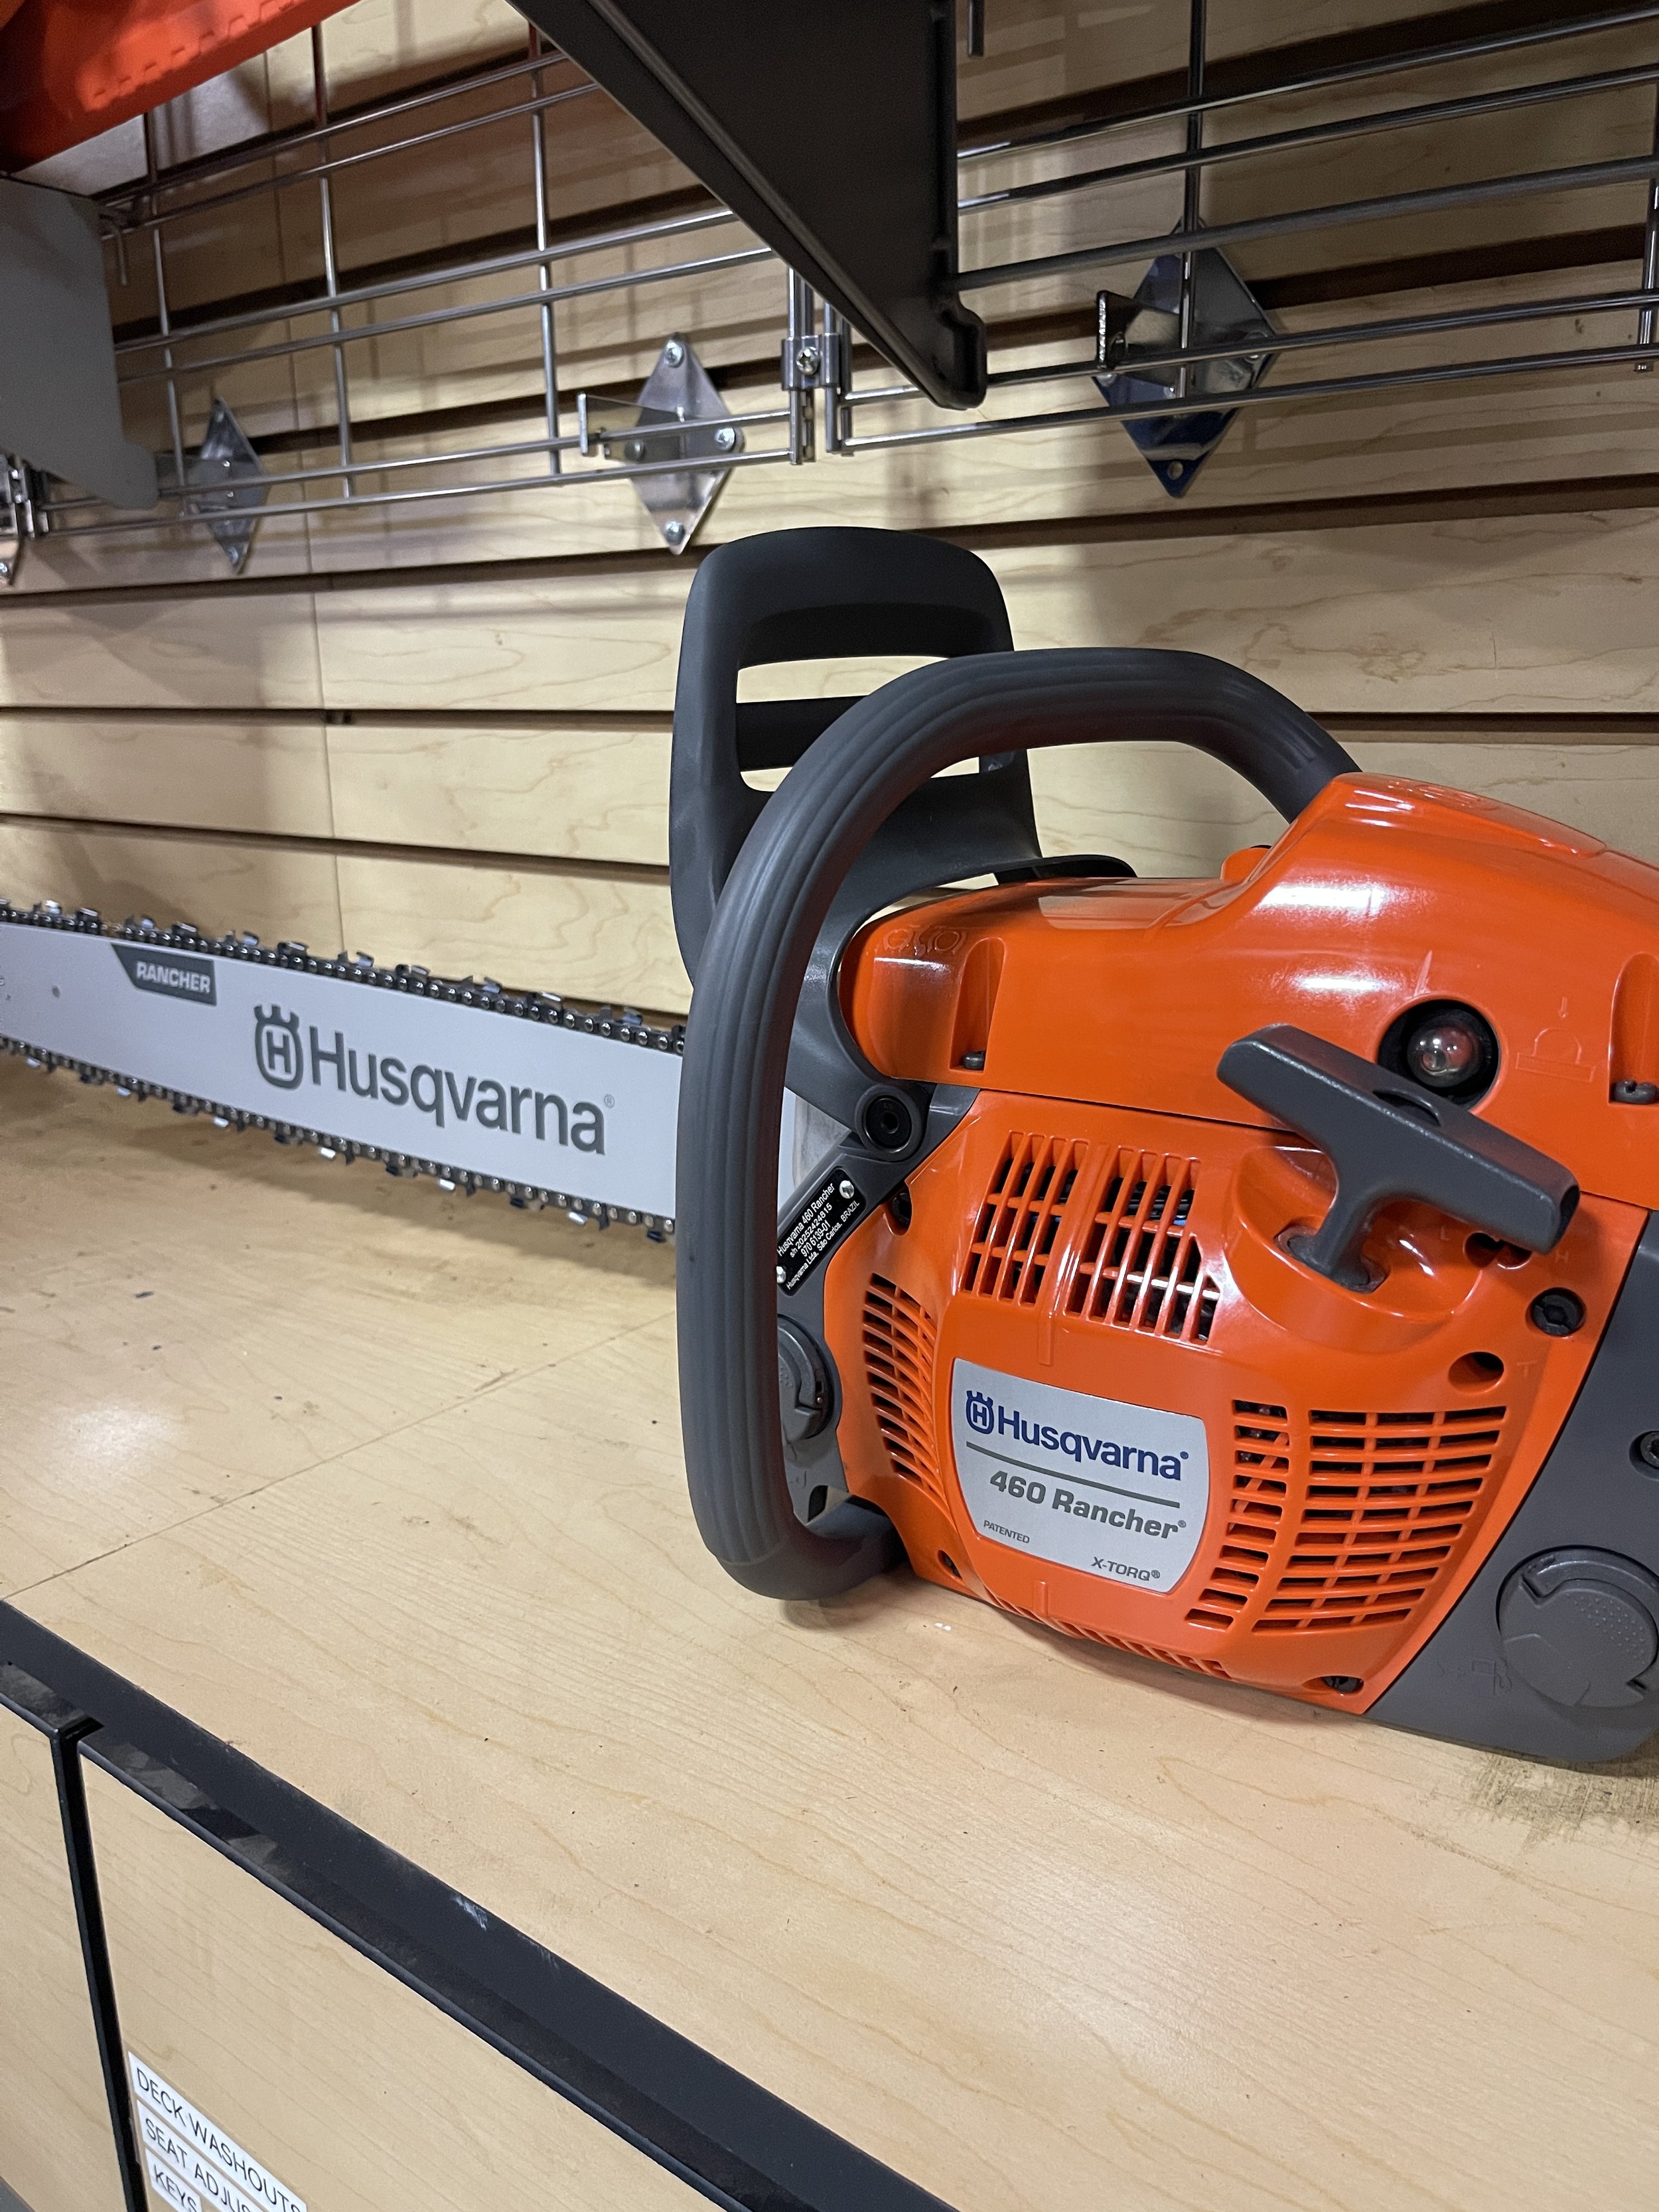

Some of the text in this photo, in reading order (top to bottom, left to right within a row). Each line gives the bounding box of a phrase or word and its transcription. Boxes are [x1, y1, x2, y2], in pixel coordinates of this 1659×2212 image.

[137, 961, 210, 994] RANCHER
[776, 1183, 835, 1256] Husqvarna 460 Rancher
[797, 1203, 832, 1251] 20252424815
[800, 1219, 831, 1257] 970 6139-01
[786, 1262, 808, 1290] Husqvarna
[840, 1201, 860, 1222] BRAZIL
[989, 1470, 1046, 1505] 460
[983, 1519, 1030, 1544] PATENTED
[137, 2067, 186, 2128] DECK
[145, 2118, 188, 2169] SEAT
[154, 2164, 197, 2212] KEYS
